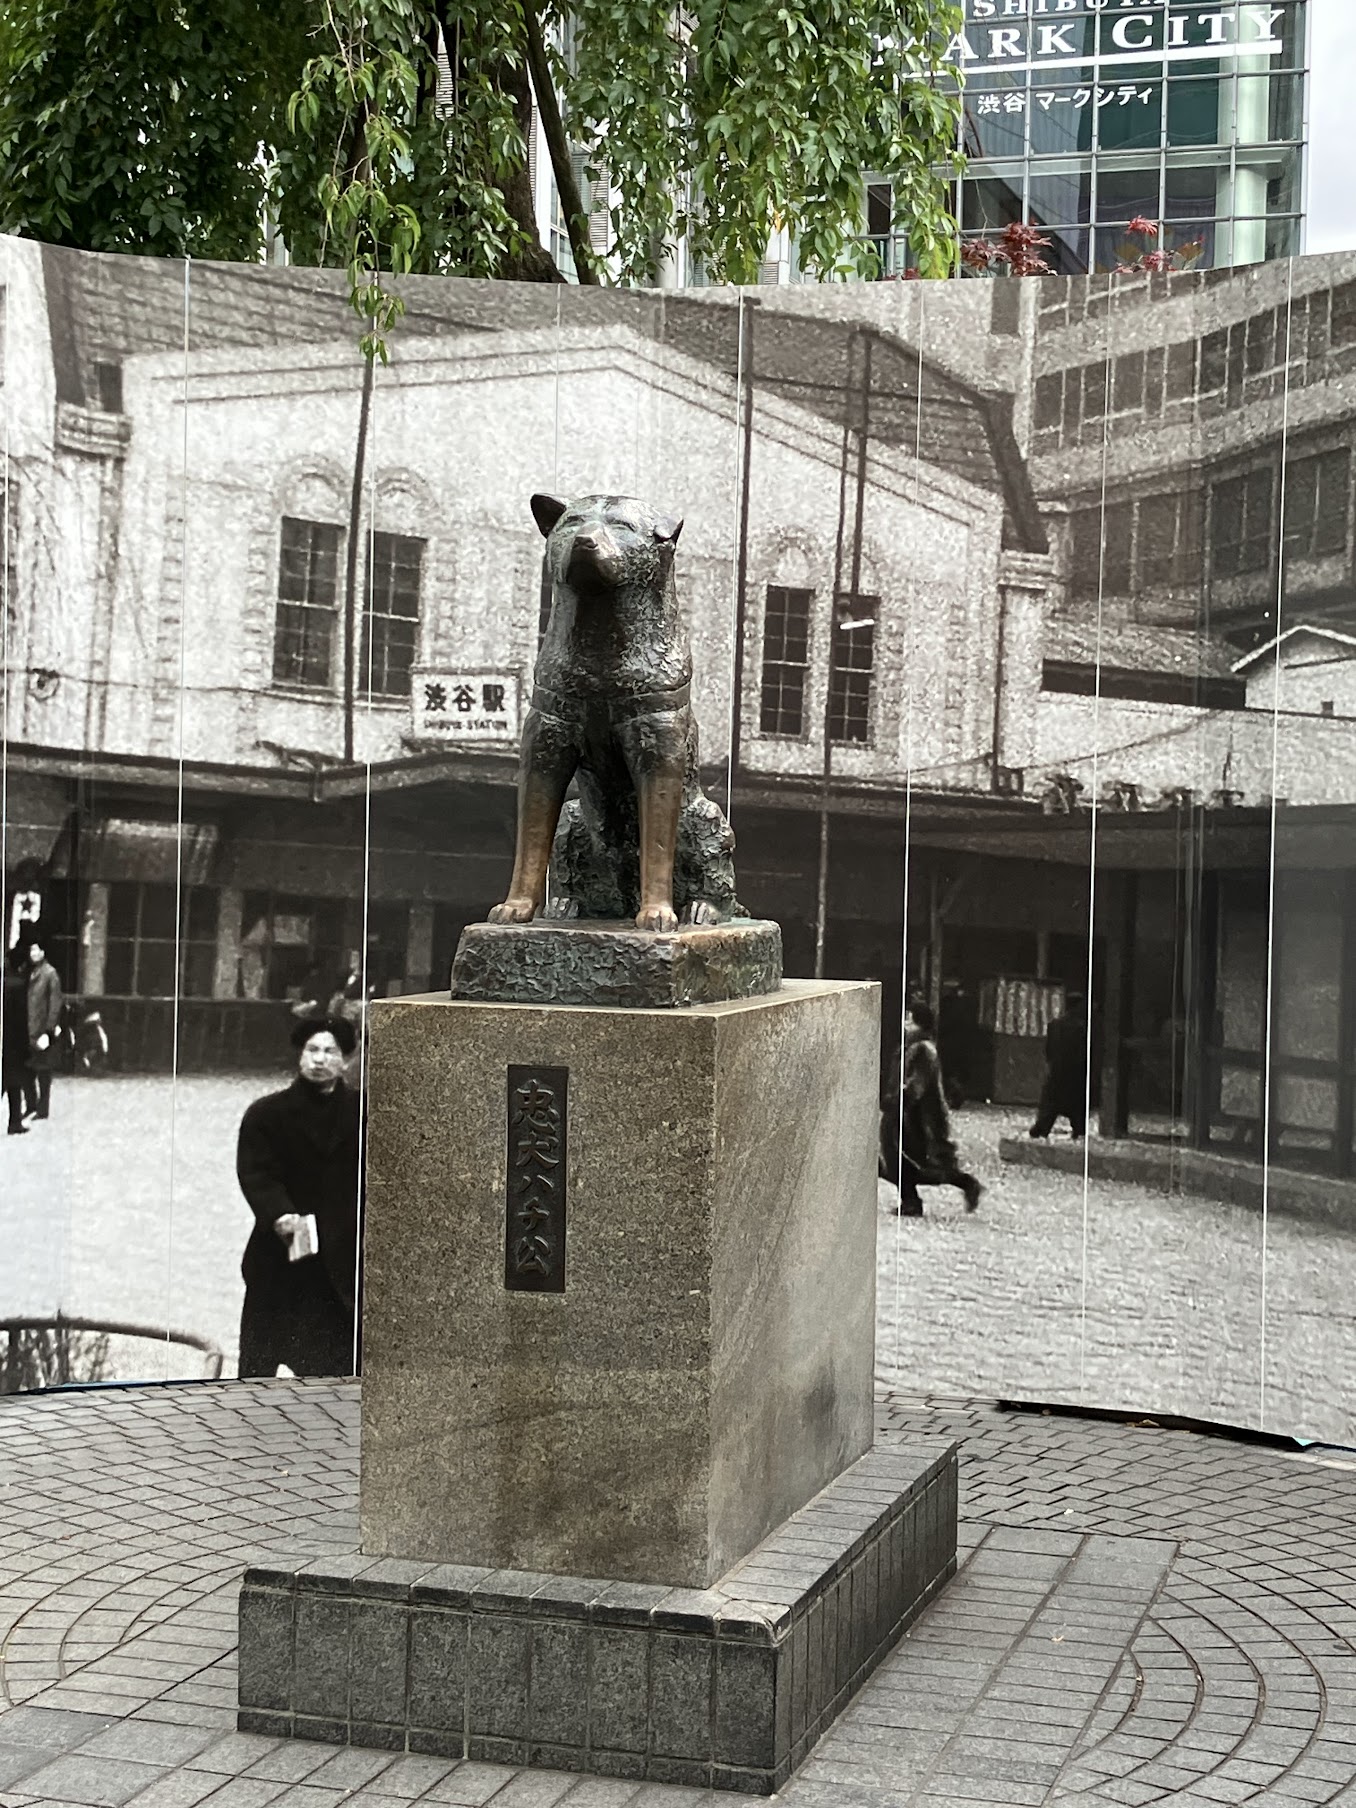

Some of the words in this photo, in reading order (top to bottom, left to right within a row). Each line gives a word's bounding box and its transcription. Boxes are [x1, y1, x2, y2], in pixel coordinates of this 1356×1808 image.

[973, 0, 1166, 17] SHIB
[1112, 9, 1286, 49] CITY
[977, 92, 1026, 115] 渋谷
[1035, 85, 1153, 111] マークシティ
[424, 683, 506, 712] 渋谷駅
[511, 1078, 560, 1276] 忠犬ハチ公
